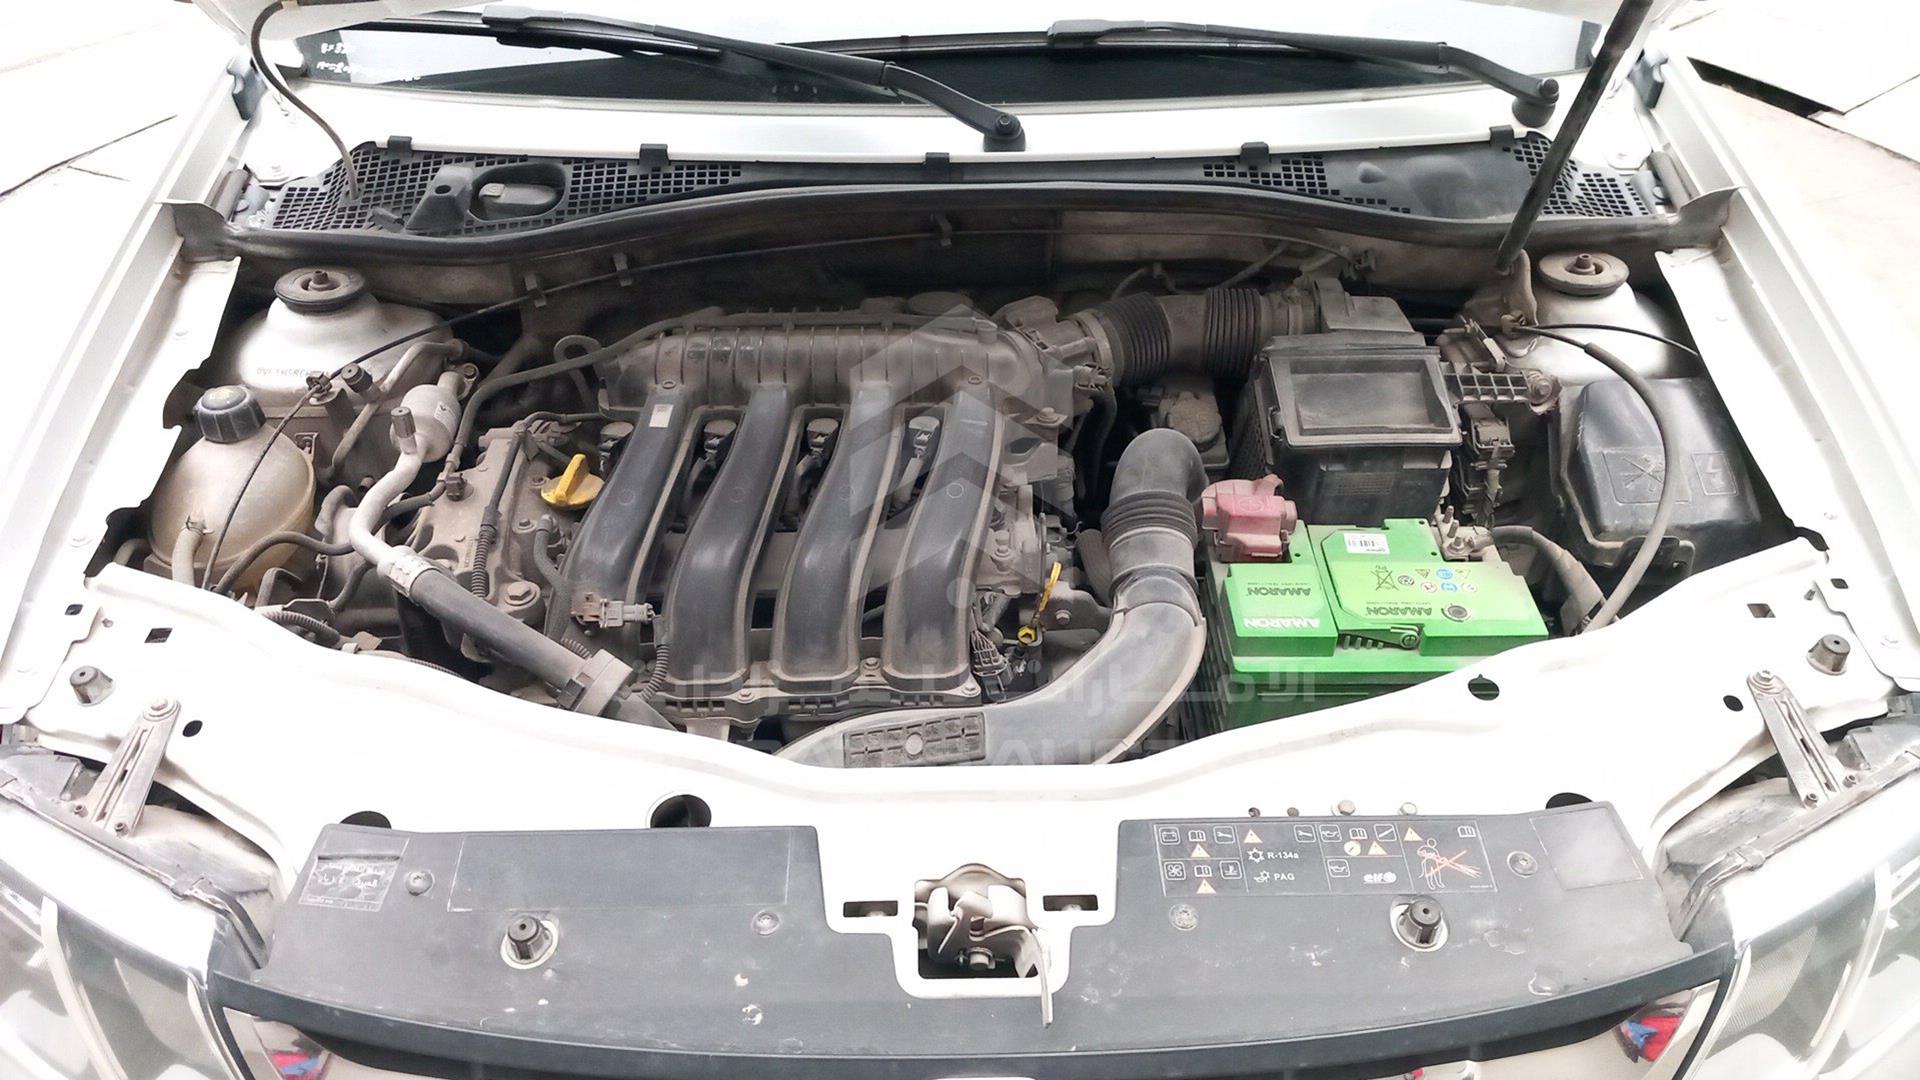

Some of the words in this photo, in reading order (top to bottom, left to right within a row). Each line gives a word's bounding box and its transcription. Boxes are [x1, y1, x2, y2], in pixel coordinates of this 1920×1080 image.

[1246, 586, 1311, 596] AMARON
[1366, 606, 1432, 616] AMARON
[1243, 617, 1319, 629] AMARON
[1266, 851, 1299, 860] R-134a
[1273, 872, 1296, 881] PAG
